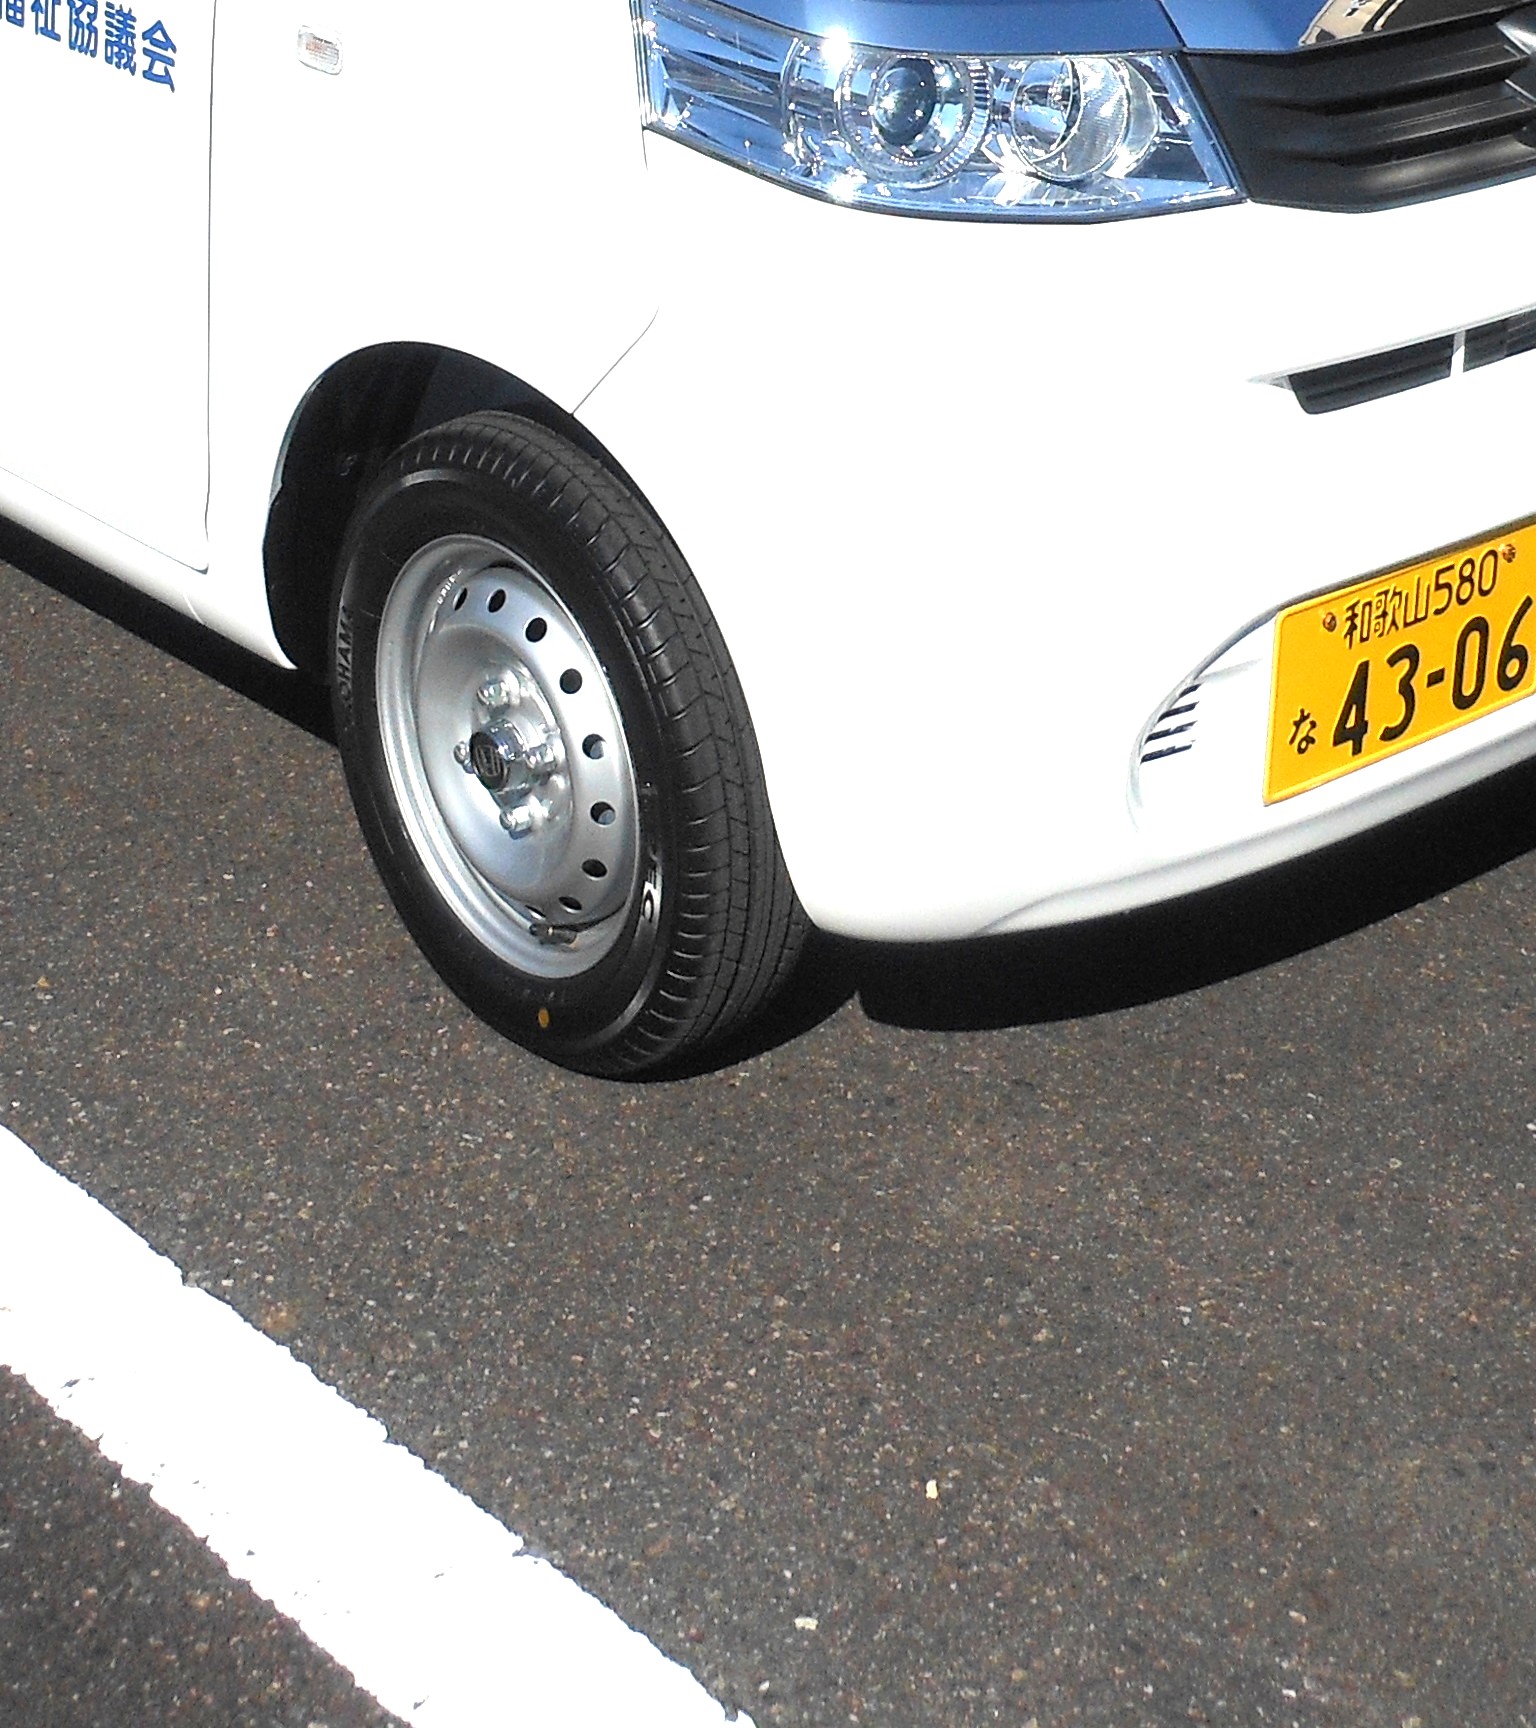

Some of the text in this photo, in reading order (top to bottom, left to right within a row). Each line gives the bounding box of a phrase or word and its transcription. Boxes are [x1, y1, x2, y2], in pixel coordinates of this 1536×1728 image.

[1343, 549, 1498, 649] 和歌山580
[1289, 595, 1533, 757] な 43-06
